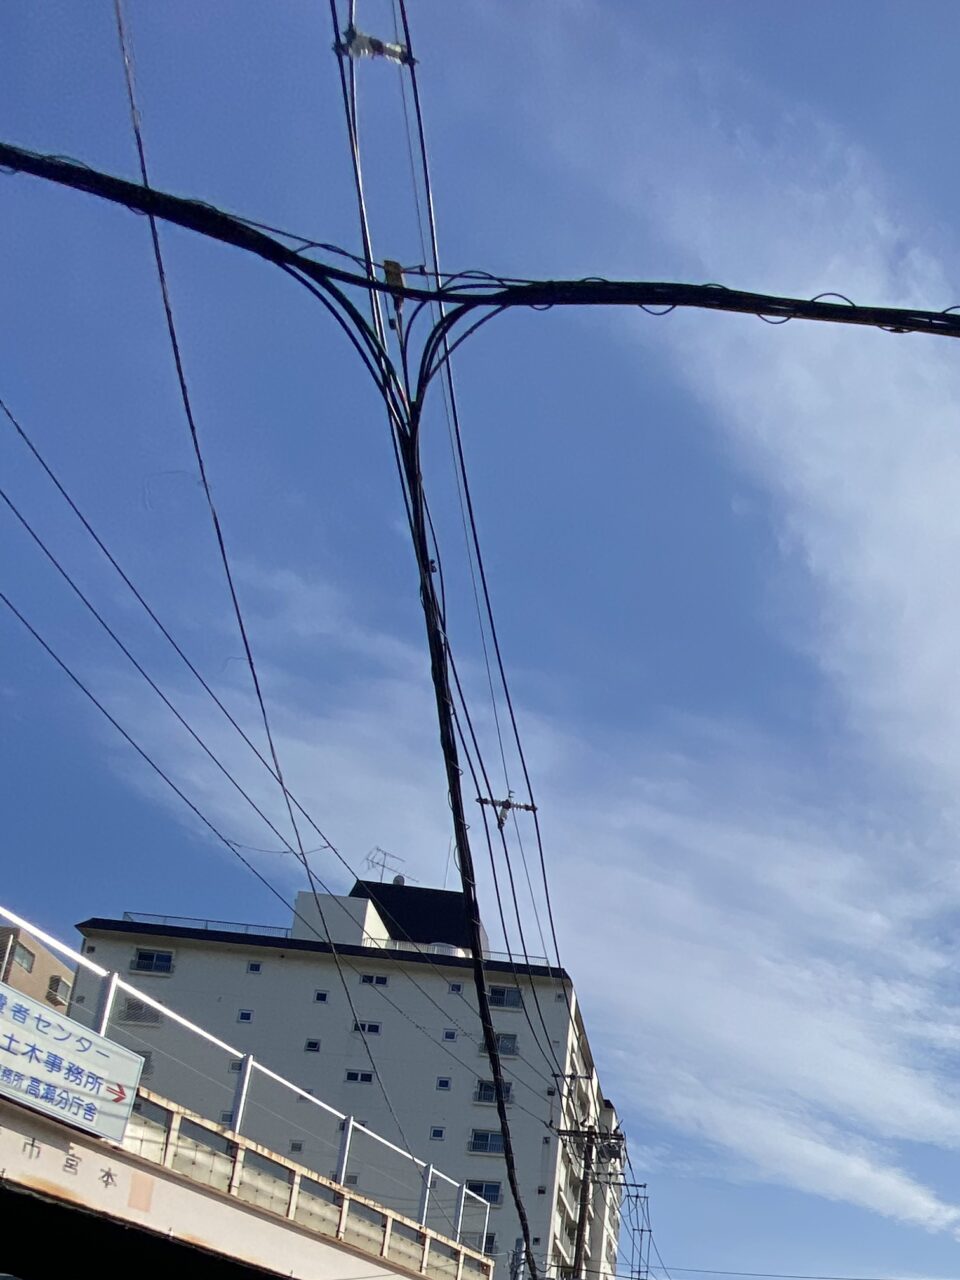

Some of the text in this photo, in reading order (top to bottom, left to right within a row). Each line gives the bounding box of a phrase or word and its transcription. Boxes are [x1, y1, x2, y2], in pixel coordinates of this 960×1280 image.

[0, 1033, 104, 1095] 土木事務所
[26, 1076, 98, 1122] 高瀬分庁舎
